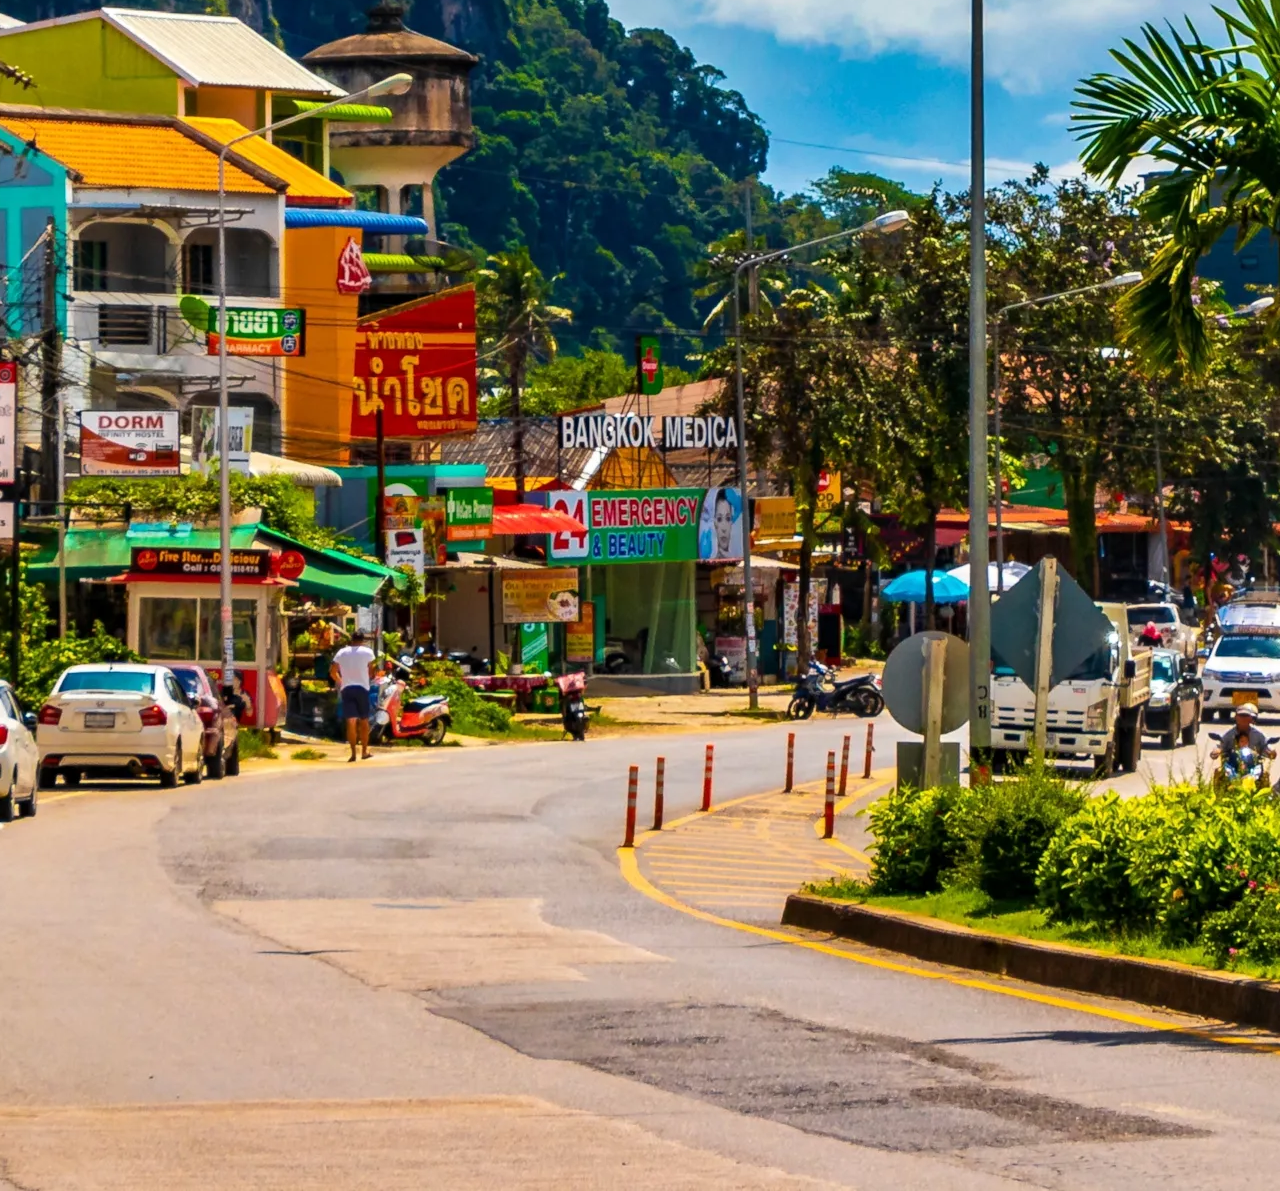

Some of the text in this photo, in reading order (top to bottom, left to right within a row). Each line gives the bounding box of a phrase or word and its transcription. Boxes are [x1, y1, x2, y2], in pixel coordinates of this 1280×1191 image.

[352, 354, 470, 417] นำโชค
[98, 415, 164, 429] DORM
[562, 416, 657, 449] BANGKOK
[590, 496, 699, 528] EMERGENCY
[159, 551, 180, 563] Five
[592, 531, 666, 558] & BEAUTY
[182, 563, 203, 573] Call
